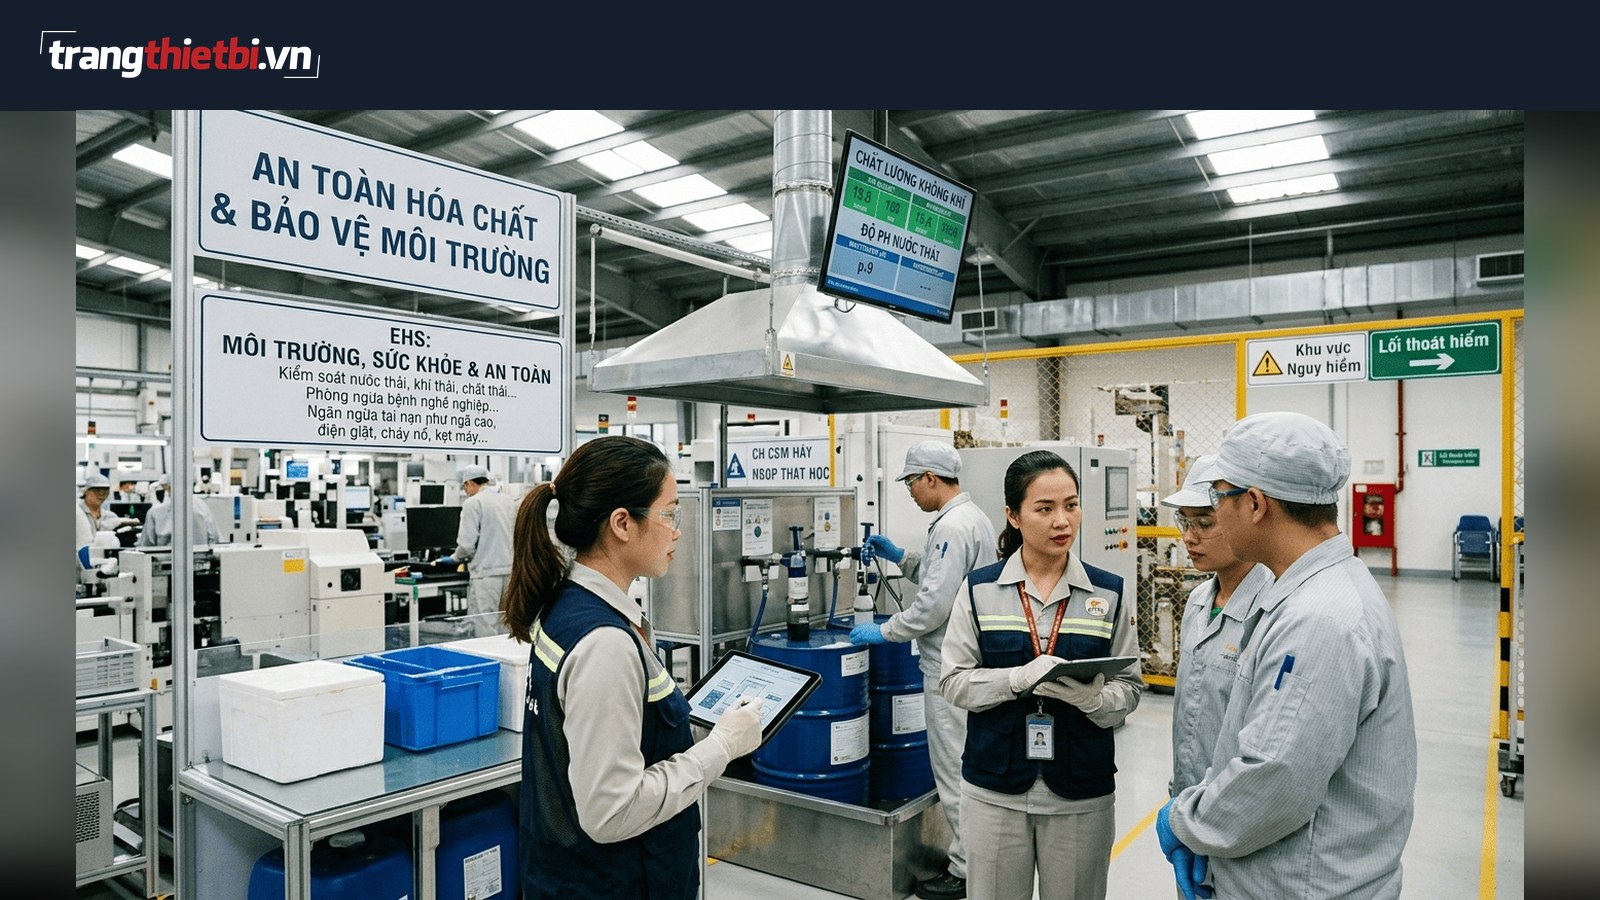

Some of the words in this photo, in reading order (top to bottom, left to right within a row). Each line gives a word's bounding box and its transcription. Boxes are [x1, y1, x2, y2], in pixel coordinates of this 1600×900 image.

[252, 151, 300, 190] AN
[311, 167, 395, 211] TOÀN
[407, 187, 464, 226] HÓA
[473, 204, 538, 241] CHẤT
[211, 192, 237, 226] &
[251, 195, 320, 241] BẢO
[331, 214, 370, 257] VỆ
[381, 226, 436, 263] MÔI
[445, 240, 550, 284] TRƯỜNG
[877, 229, 891, 245] PH
[390, 327, 431, 348] EHS:
[1406, 335, 1446, 351] thoát
[223, 332, 266, 357] MÔI
[273, 340, 366, 370] TRƯỜNG,
[372, 348, 410, 371] SỨC
[416, 353, 463, 376] KHỎE
[467, 361, 479, 377] &
[484, 363, 506, 380] AN
[511, 364, 551, 384] TOÀN
[1296, 343, 1322, 356] Khu
[279, 364, 314, 381] Kiểm
[317, 370, 346, 385] soát
[1287, 362, 1322, 378] Nguy
[381, 409, 397, 422] tai
[474, 418, 496, 429] cao,
[752, 447, 765, 460] CH
[768, 446, 789, 459] CSM
[781, 467, 806, 480] THAT
[809, 466, 830, 480] HOC
